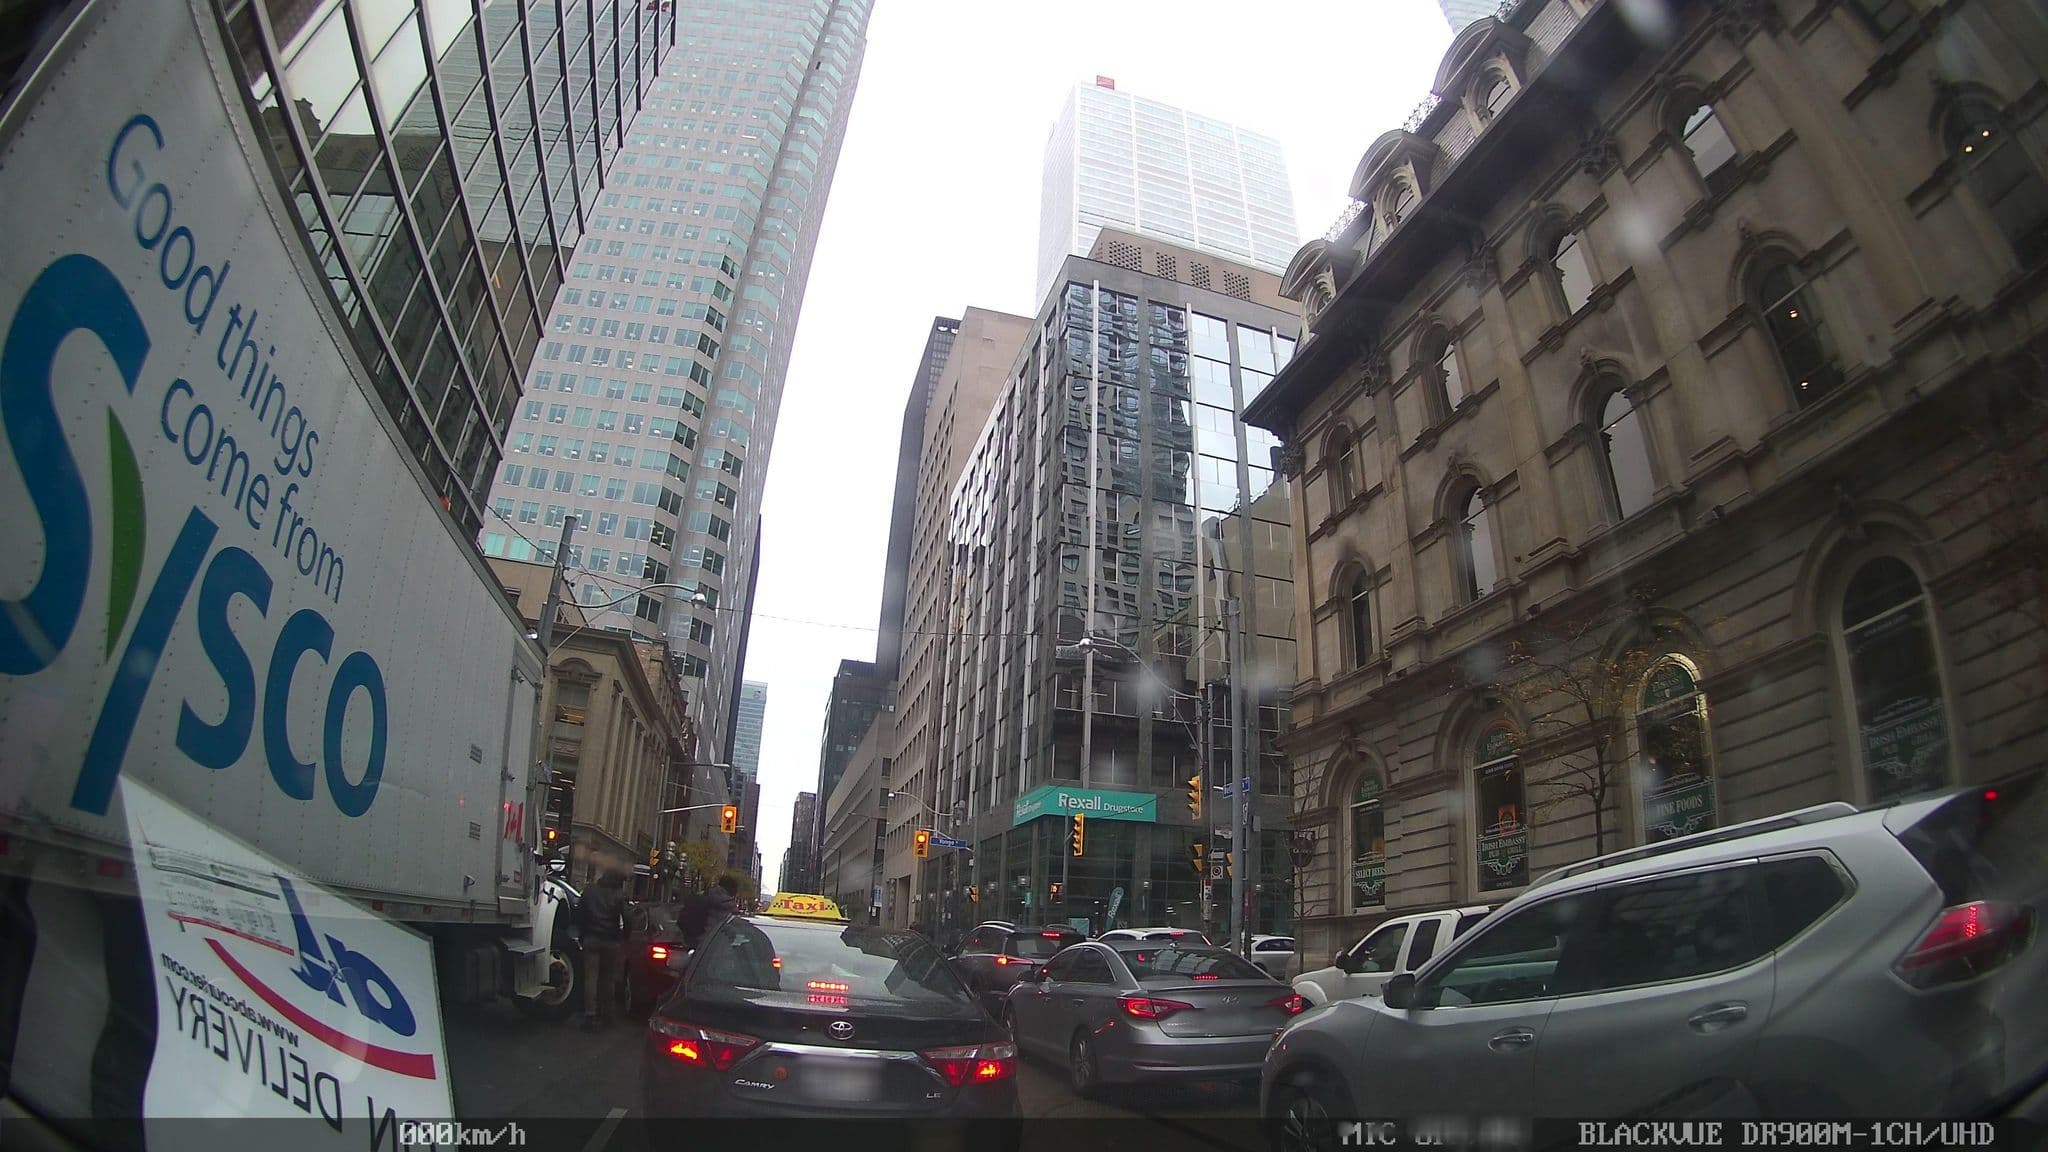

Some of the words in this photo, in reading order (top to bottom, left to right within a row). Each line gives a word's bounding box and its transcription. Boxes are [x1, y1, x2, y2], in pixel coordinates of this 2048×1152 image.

[108, 113, 232, 336] Good
[216, 304, 320, 478] things
[161, 377, 271, 530] come
[272, 483, 346, 604] from
[1058, 792, 1101, 811] Rexall
[1103, 802, 1144, 814] Drugstore
[780, 898, 826, 911] Taxi
[734, 1078, 776, 1091] CAMRY
